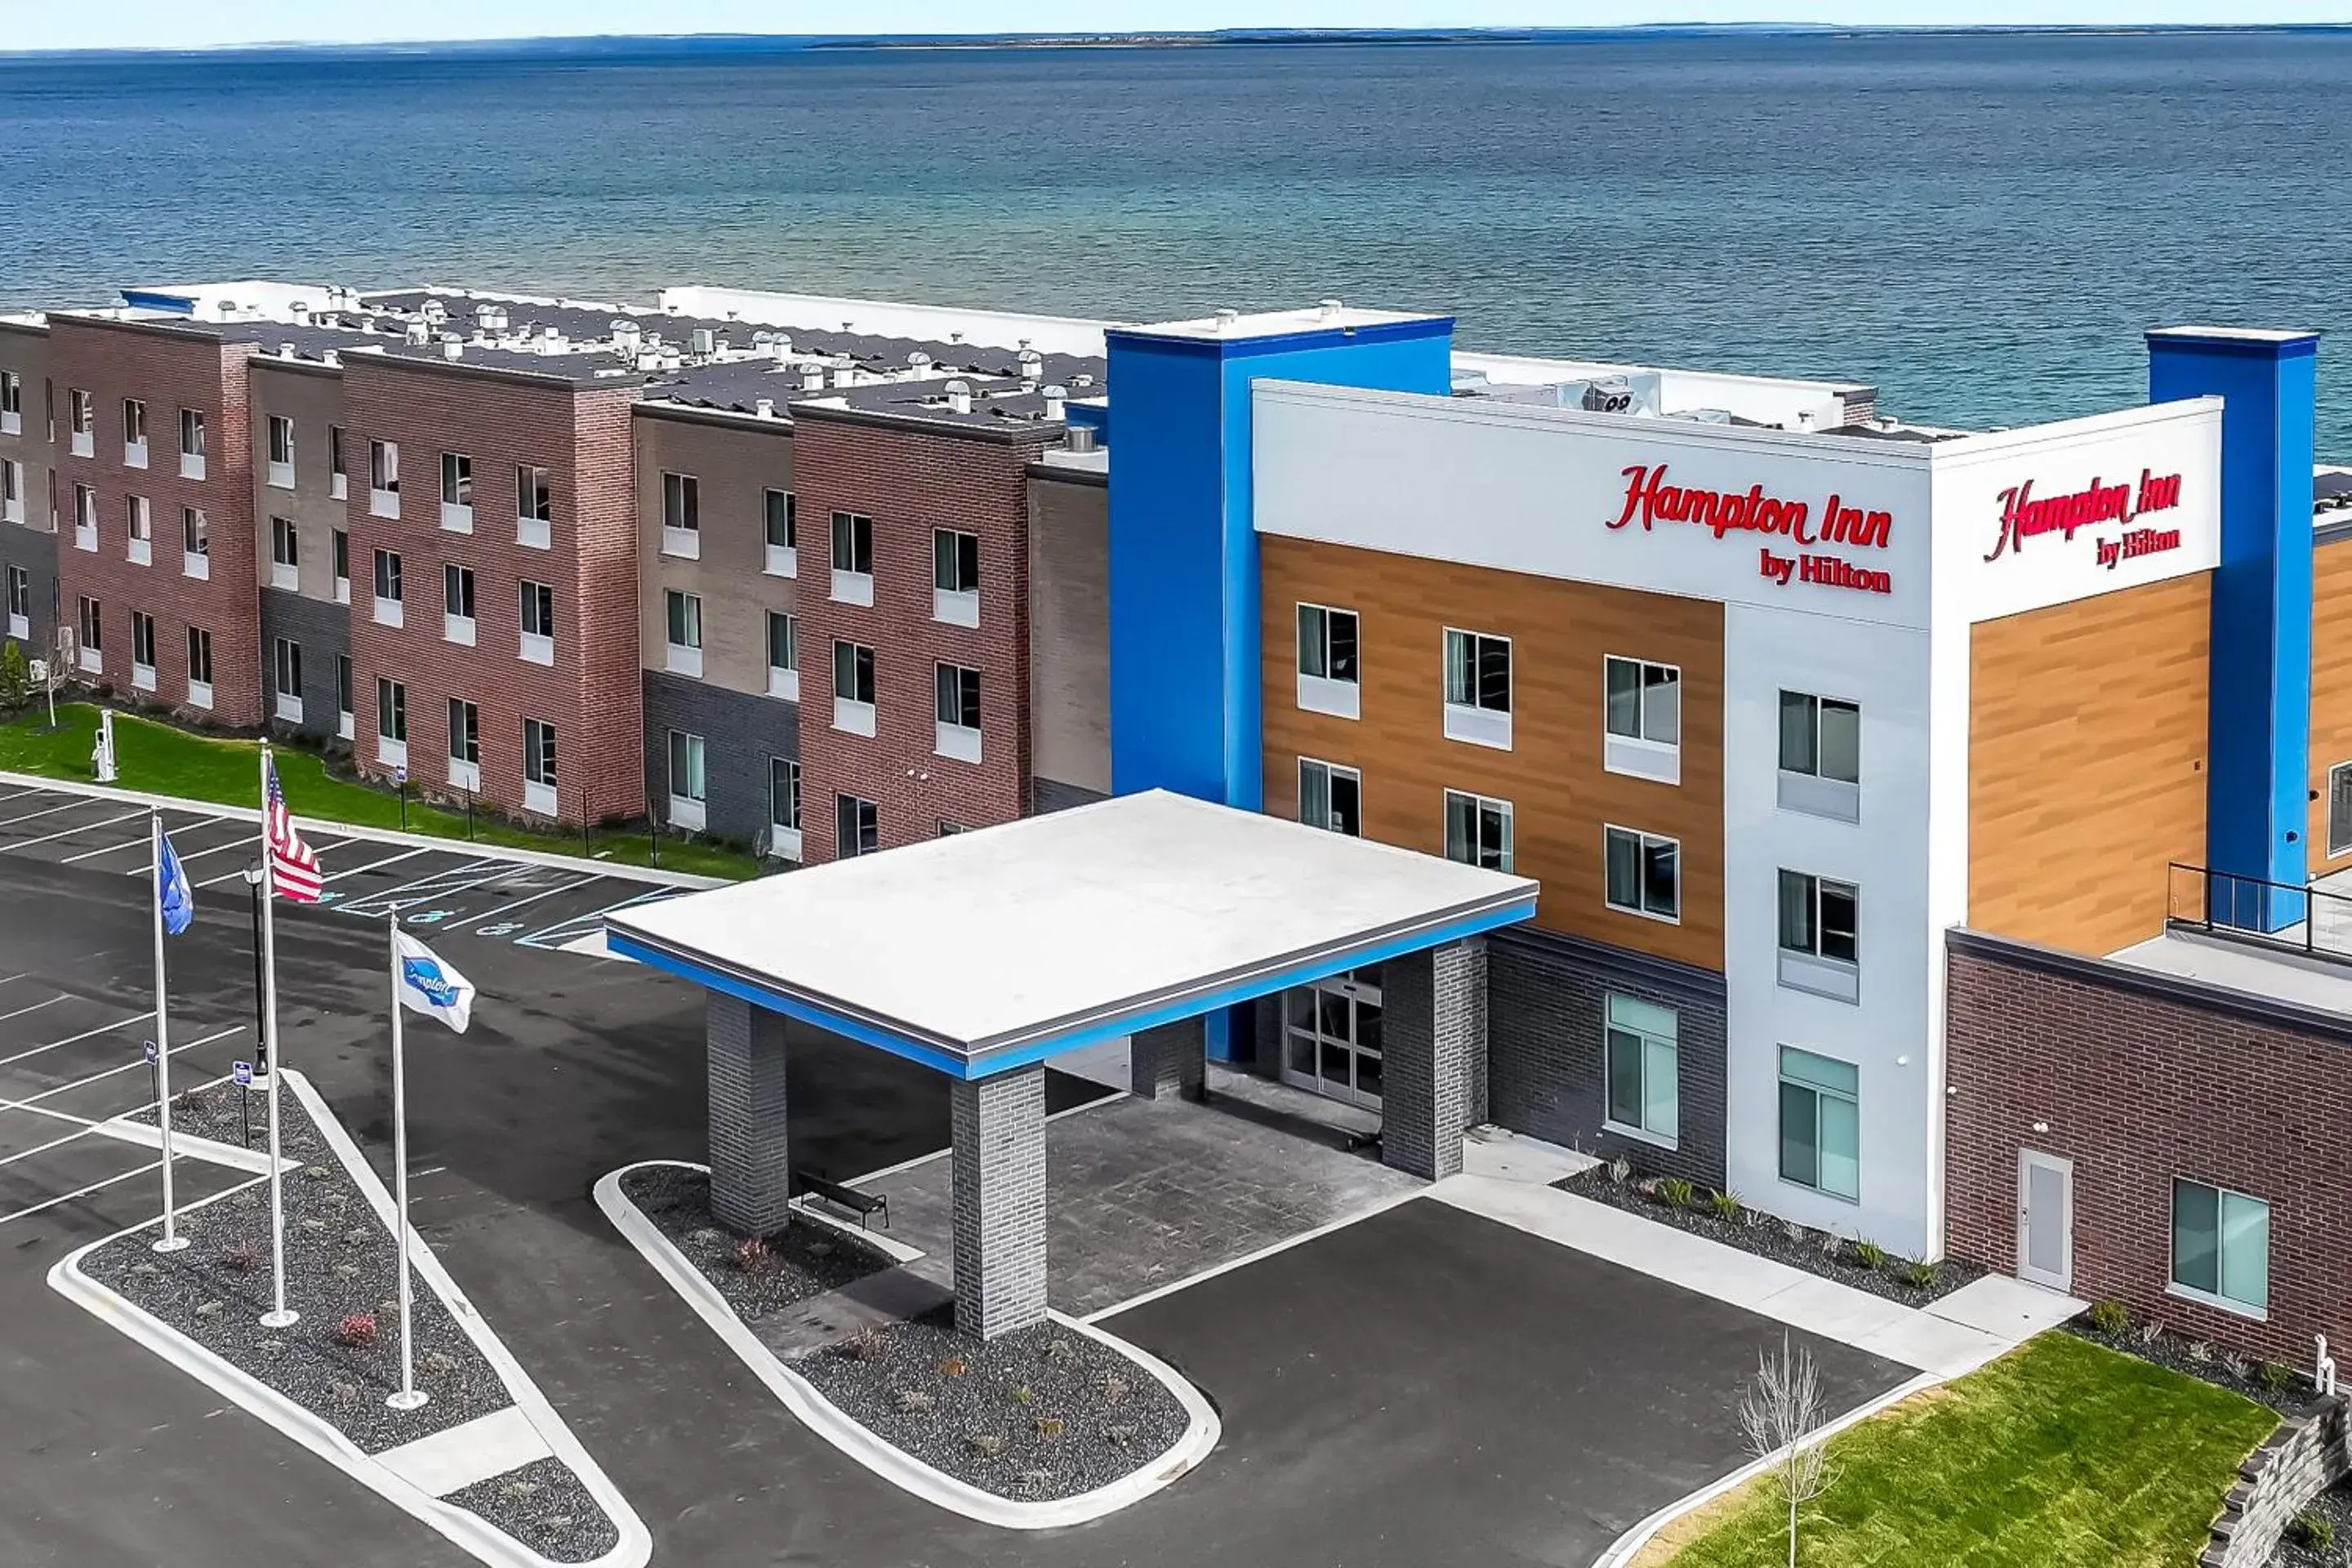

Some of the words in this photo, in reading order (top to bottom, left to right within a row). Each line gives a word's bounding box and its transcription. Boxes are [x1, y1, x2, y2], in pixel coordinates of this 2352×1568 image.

[1605, 464, 1815, 545] Hampton
[1820, 494, 1892, 548] Inn
[1983, 477, 2136, 562] Hampton
[2136, 468, 2181, 514] Inn
[1760, 548, 1795, 586] by
[1799, 555, 1891, 593] Hilton
[2096, 537, 2121, 570] by
[2123, 528, 2180, 559] Hilton
